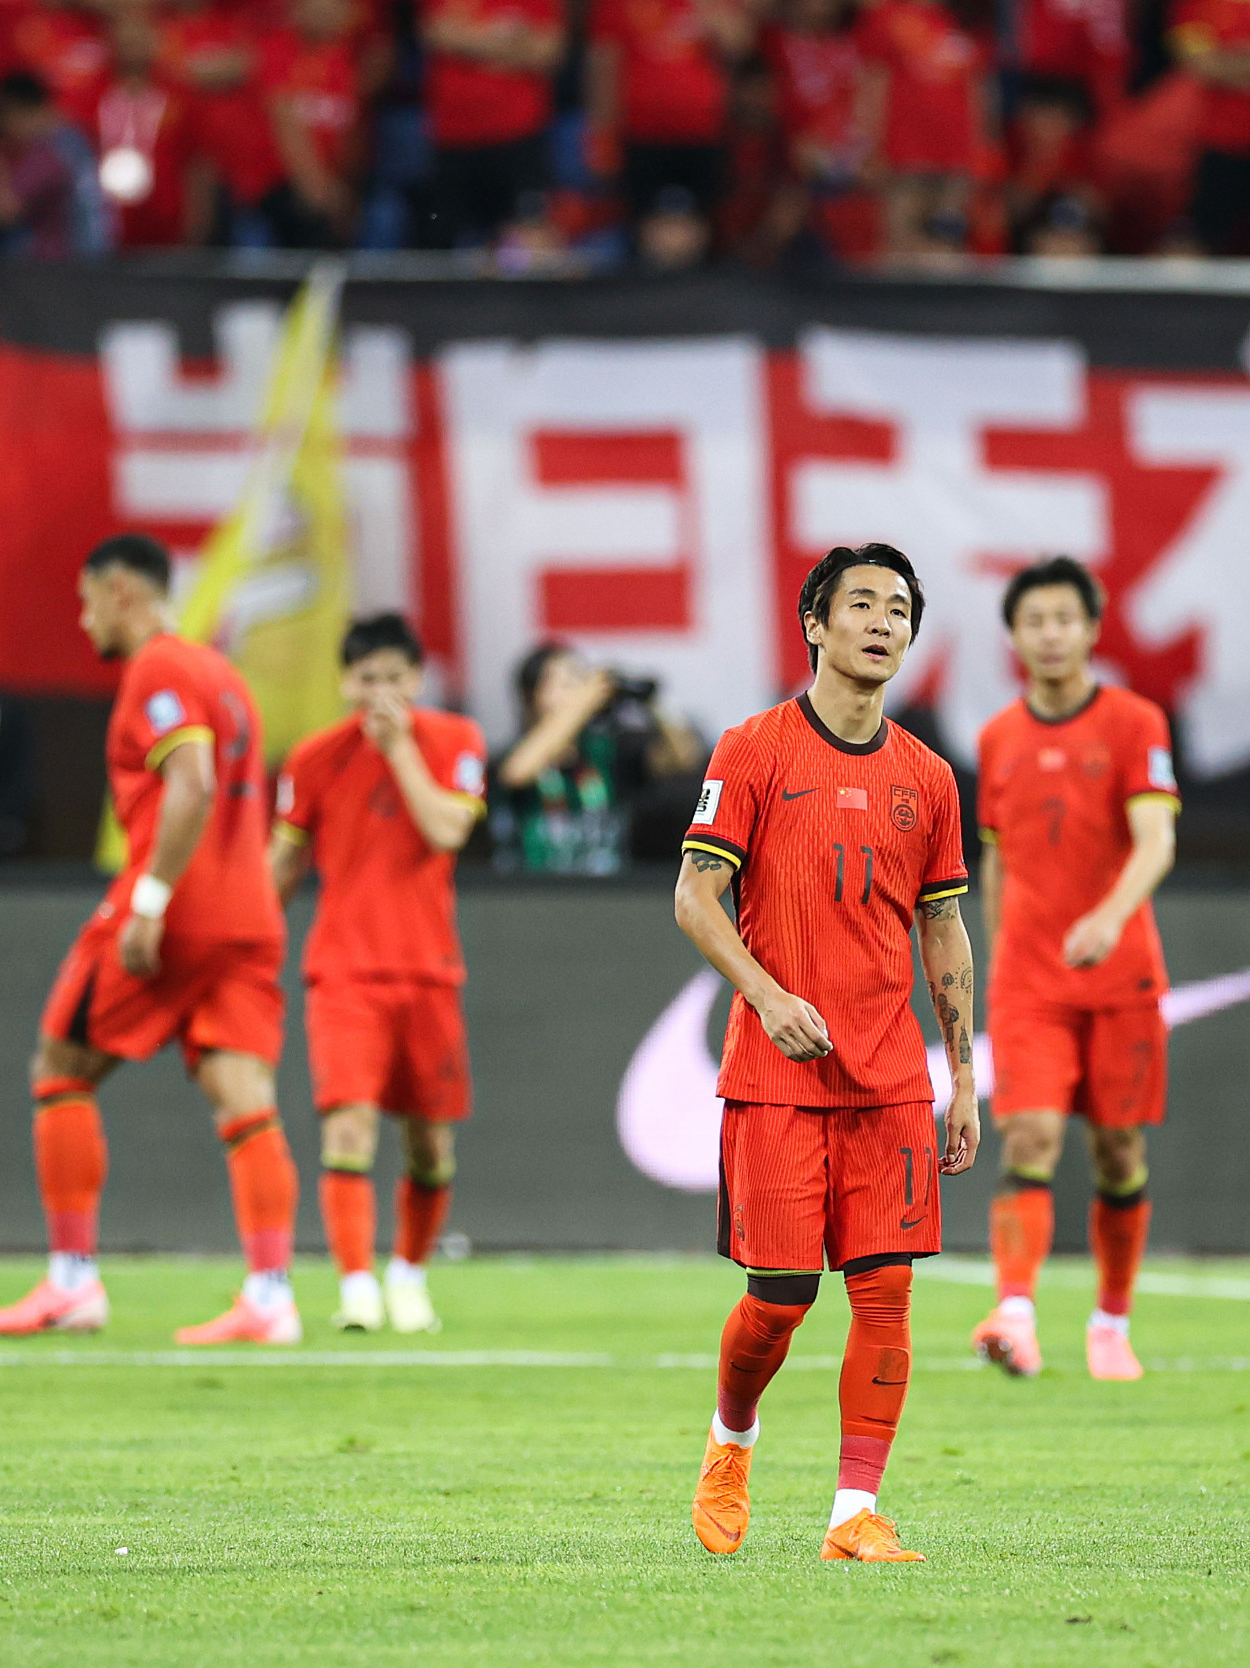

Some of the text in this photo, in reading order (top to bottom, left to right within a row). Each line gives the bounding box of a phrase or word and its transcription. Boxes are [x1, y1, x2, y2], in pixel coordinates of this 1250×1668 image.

[893, 788, 916, 800] CFA
[833, 843, 872, 904] 11
[900, 1147, 932, 1206] 11
